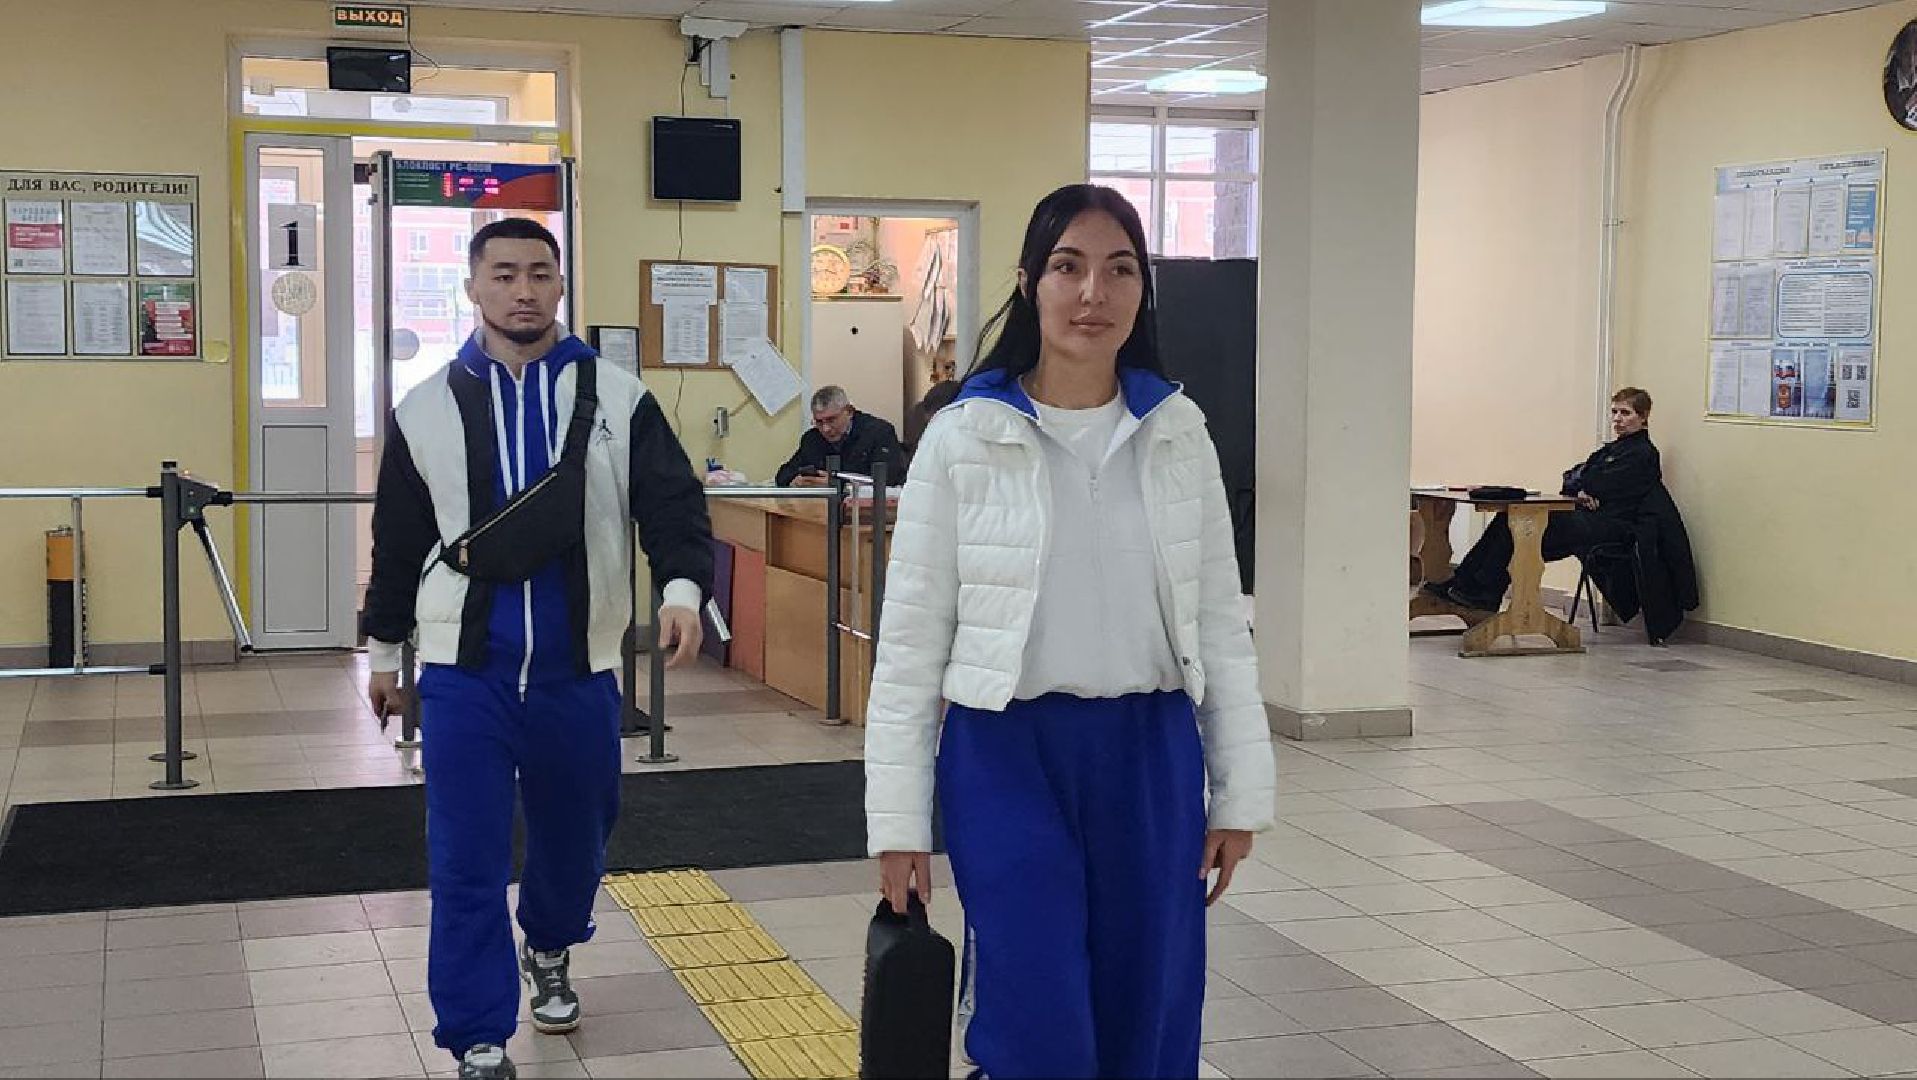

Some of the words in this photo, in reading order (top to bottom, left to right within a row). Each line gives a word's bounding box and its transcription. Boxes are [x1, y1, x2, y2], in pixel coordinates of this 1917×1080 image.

[337, 9, 403, 25] ВЫХОД
[7, 178, 42, 192] ДЛЯ
[49, 179, 86, 193] ВАС,
[93, 181, 189, 195] РОДИТЕЛИ!
[280, 221, 306, 267] 1
